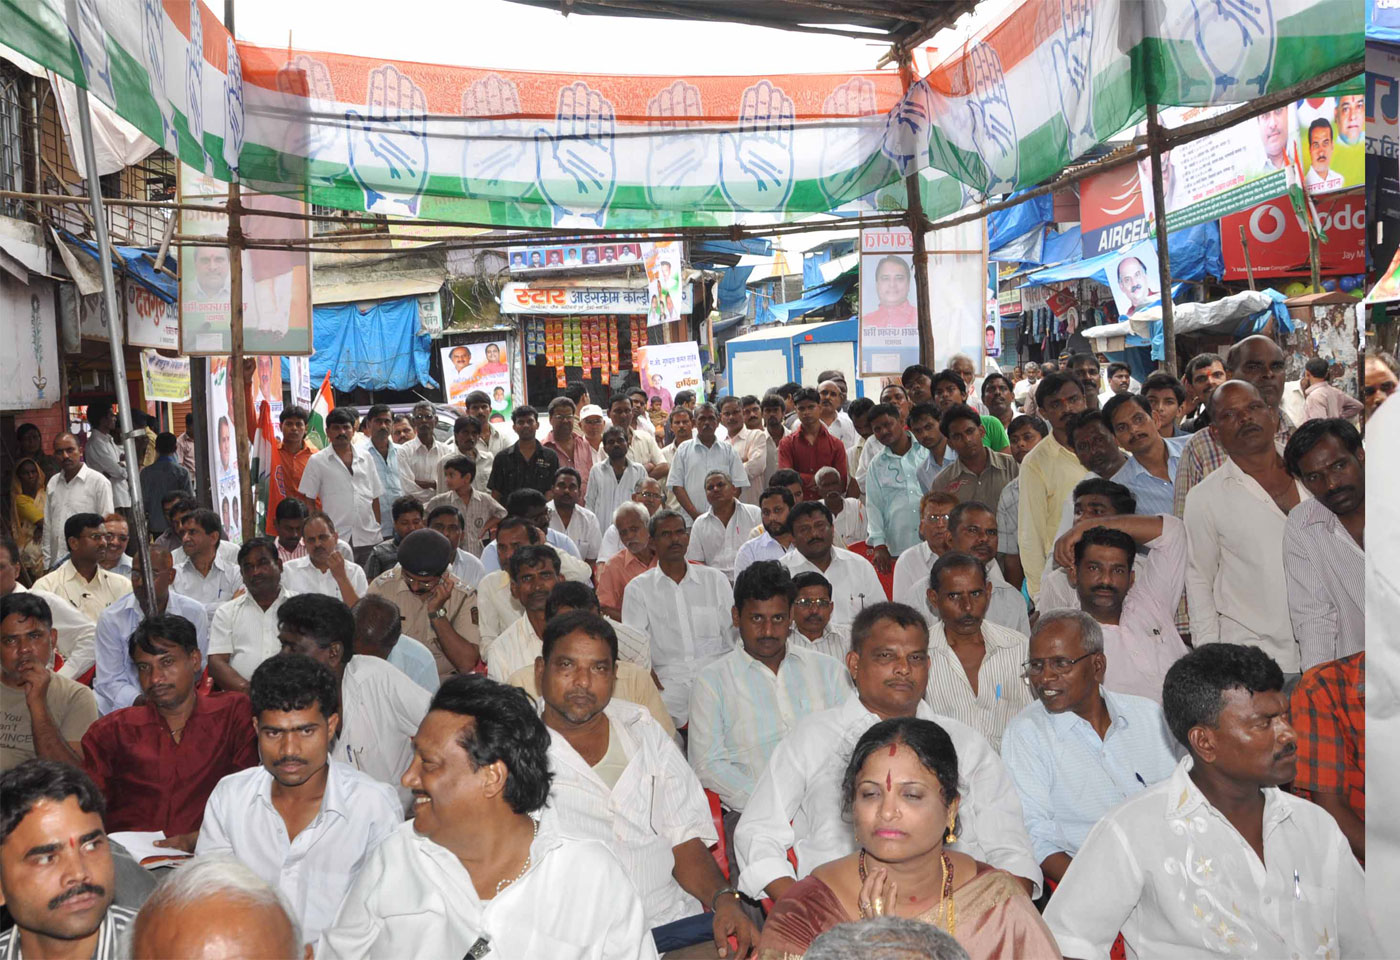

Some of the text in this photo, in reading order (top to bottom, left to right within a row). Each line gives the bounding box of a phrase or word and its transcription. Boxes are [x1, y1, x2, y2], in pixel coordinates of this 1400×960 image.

[1098, 218, 1148, 252] AIRCEL
[1342, 250, 1355, 259] Jay
[514, 288, 566, 306] स्टार
[5, 711, 22, 722] You
